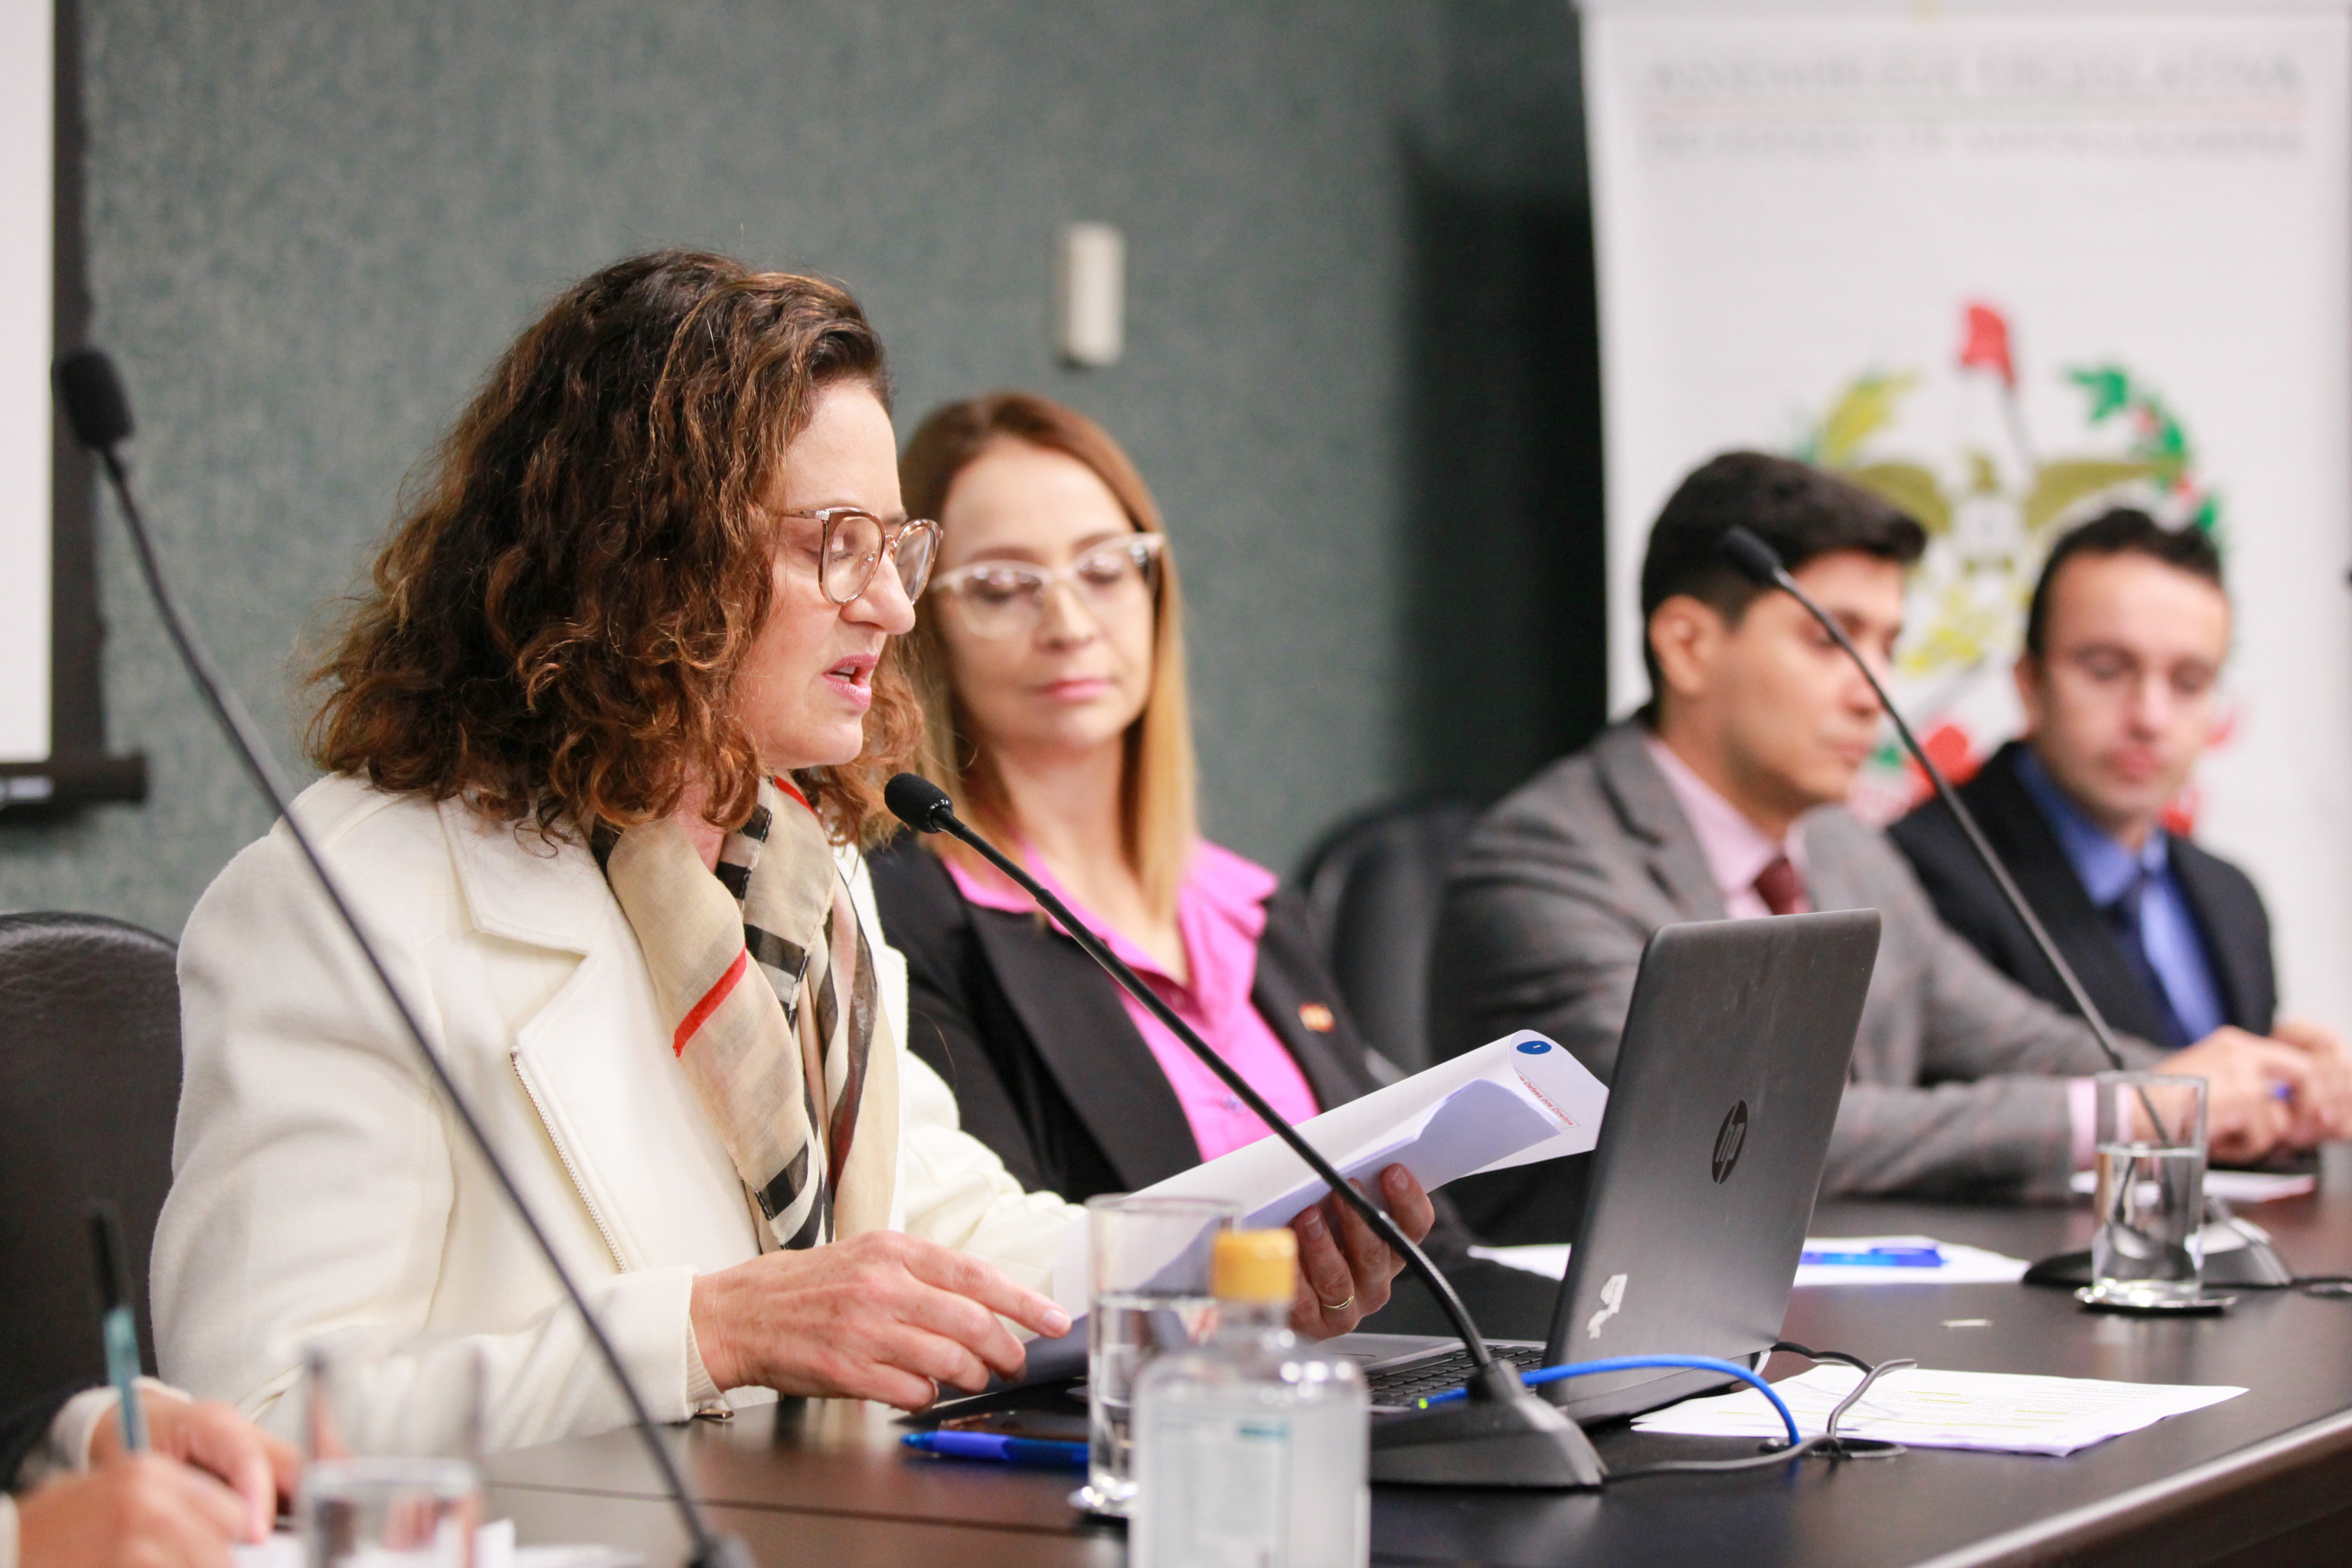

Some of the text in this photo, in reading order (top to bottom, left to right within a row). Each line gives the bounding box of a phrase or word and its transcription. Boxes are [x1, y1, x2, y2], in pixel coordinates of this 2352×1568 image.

[1524, 1081, 1543, 1098] Defesa
[1542, 1098, 1553, 1107] dos
[1552, 1107, 1573, 1125] Direitos
[1714, 1101, 1746, 1184] hp
